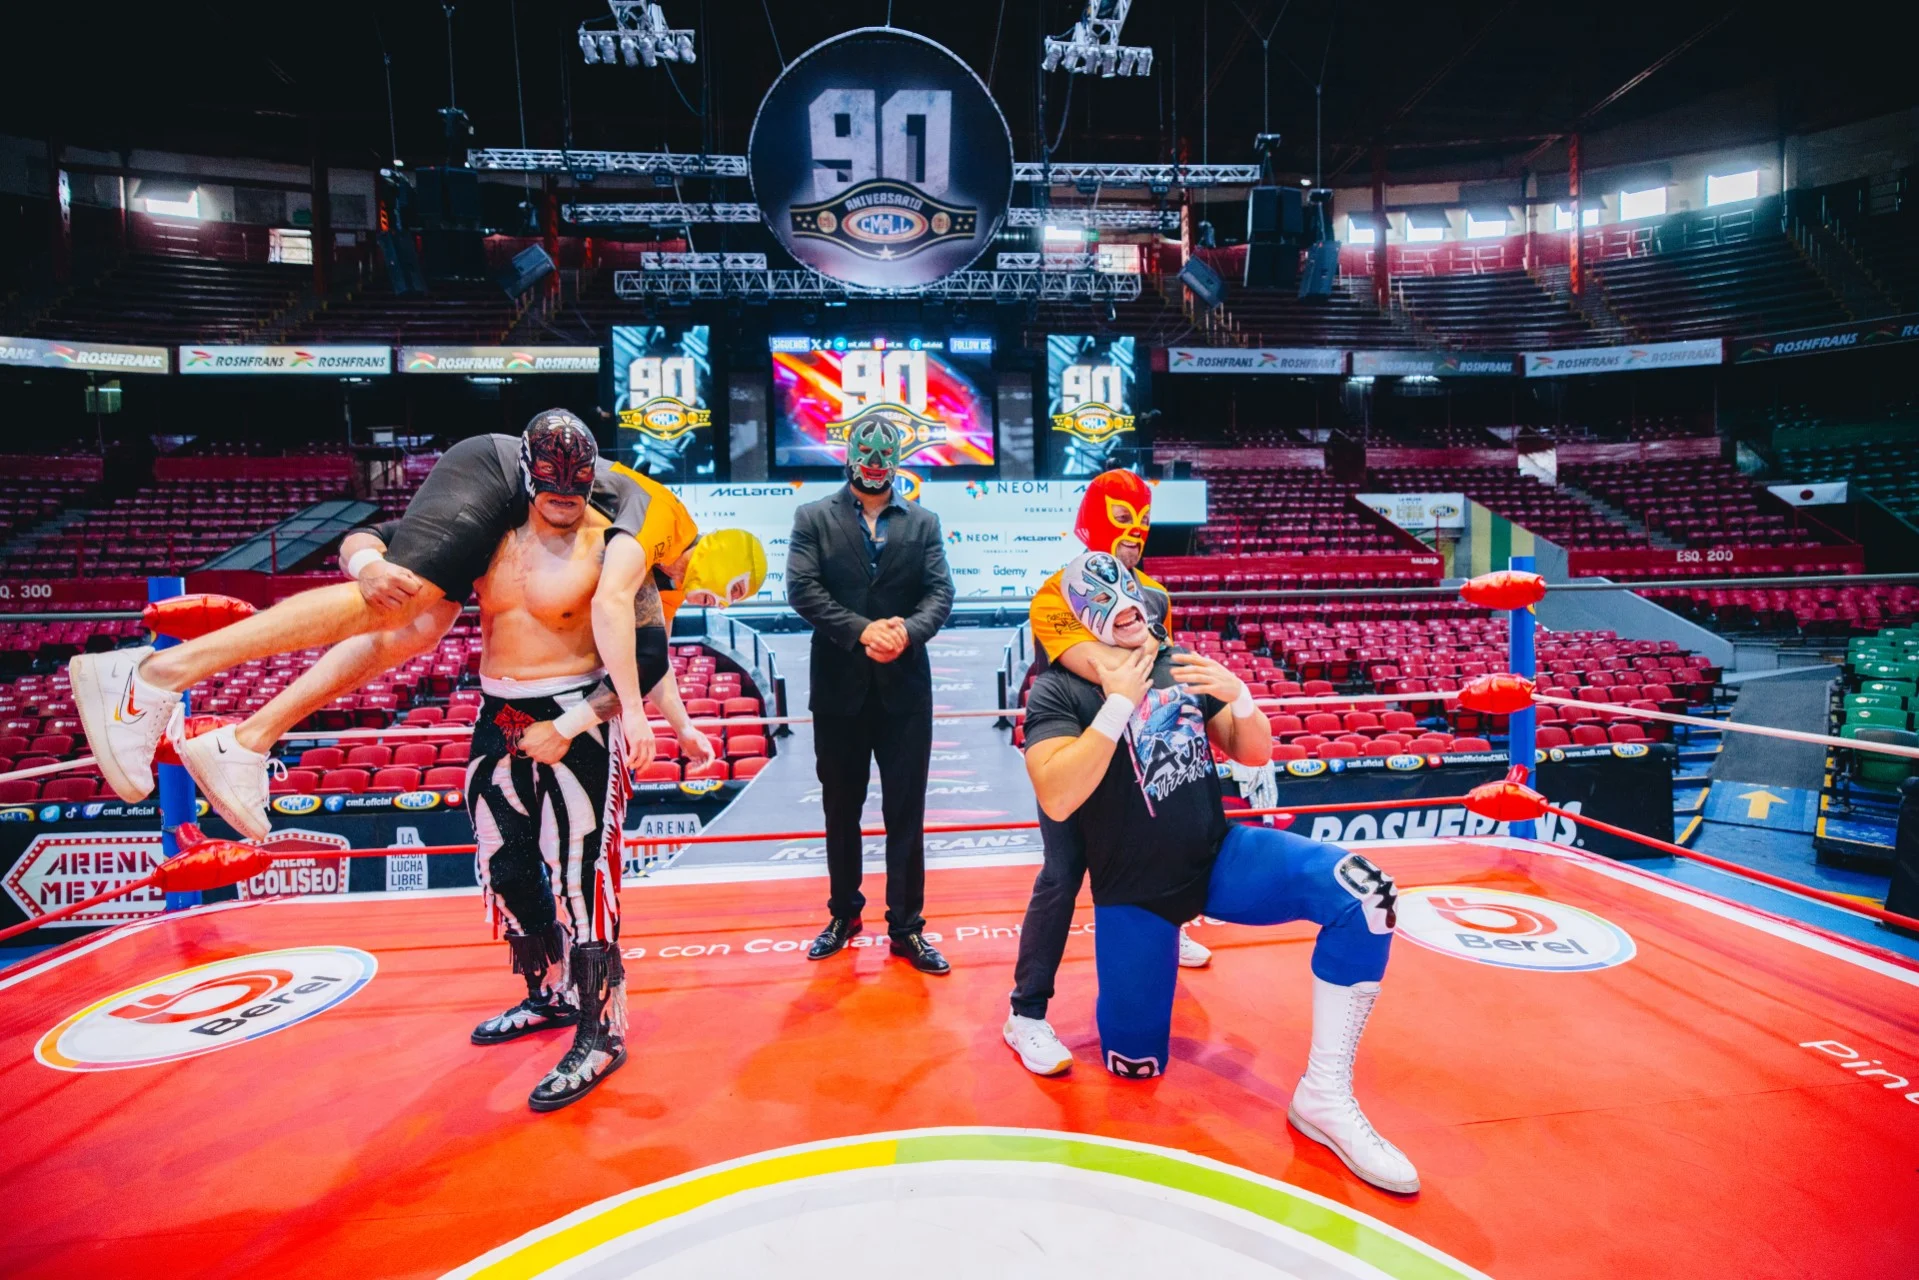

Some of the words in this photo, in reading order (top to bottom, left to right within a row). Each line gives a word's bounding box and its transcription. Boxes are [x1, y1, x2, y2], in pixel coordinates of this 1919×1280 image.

[808, 89, 951, 201] 90
[845, 192, 923, 211] ANIVERSARIO
[861, 213, 910, 234] CMLL
[1773, 333, 1858, 354] ROSHFRANS
[77, 351, 162, 367] ROSHFRANS
[216, 356, 284, 367] ROSHFRANS
[318, 356, 386, 367] ROSHFRANS
[437, 357, 504, 369] ROSHFRANS
[534, 357, 600, 369] ROSHFRANS
[1197, 357, 1253, 367] ROSHFRANS
[1281, 358, 1336, 368] ROSHFRANS
[1557, 356, 1620, 369] ROSHFRANS
[1651, 347, 1717, 363] ROSHFRANS
[1380, 361, 1434, 371] ROSHFRANS
[1459, 362, 1512, 372] ROSHFRANS
[630, 357, 695, 409] 90
[841, 350, 927, 420] 90
[1062, 366, 1122, 413] 90
[709, 488, 793, 497] McLaren
[997, 482, 1049, 493] NEOM
[967, 534, 999, 542] NEOM
[1677, 551, 1703, 562] ESQ.
[1707, 550, 1734, 561] 200
[0, 585, 15, 599] Q.
[20, 584, 52, 598] 300
[280, 796, 313, 811] CMLL
[346, 796, 392, 807] cmll.oficial
[103, 806, 154, 817] cmll_oficial
[646, 820, 696, 834] ARENA
[401, 833, 413, 844] LA
[45, 851, 159, 875] ARENA
[391, 859, 423, 872] LUCHA
[250, 867, 337, 895] COLISEO
[391, 874, 423, 886] LIBRE
[659, 942, 730, 957] con
[957, 924, 1022, 942] Pint
[1455, 933, 1589, 955] Berel
[189, 975, 342, 1036] Berel
